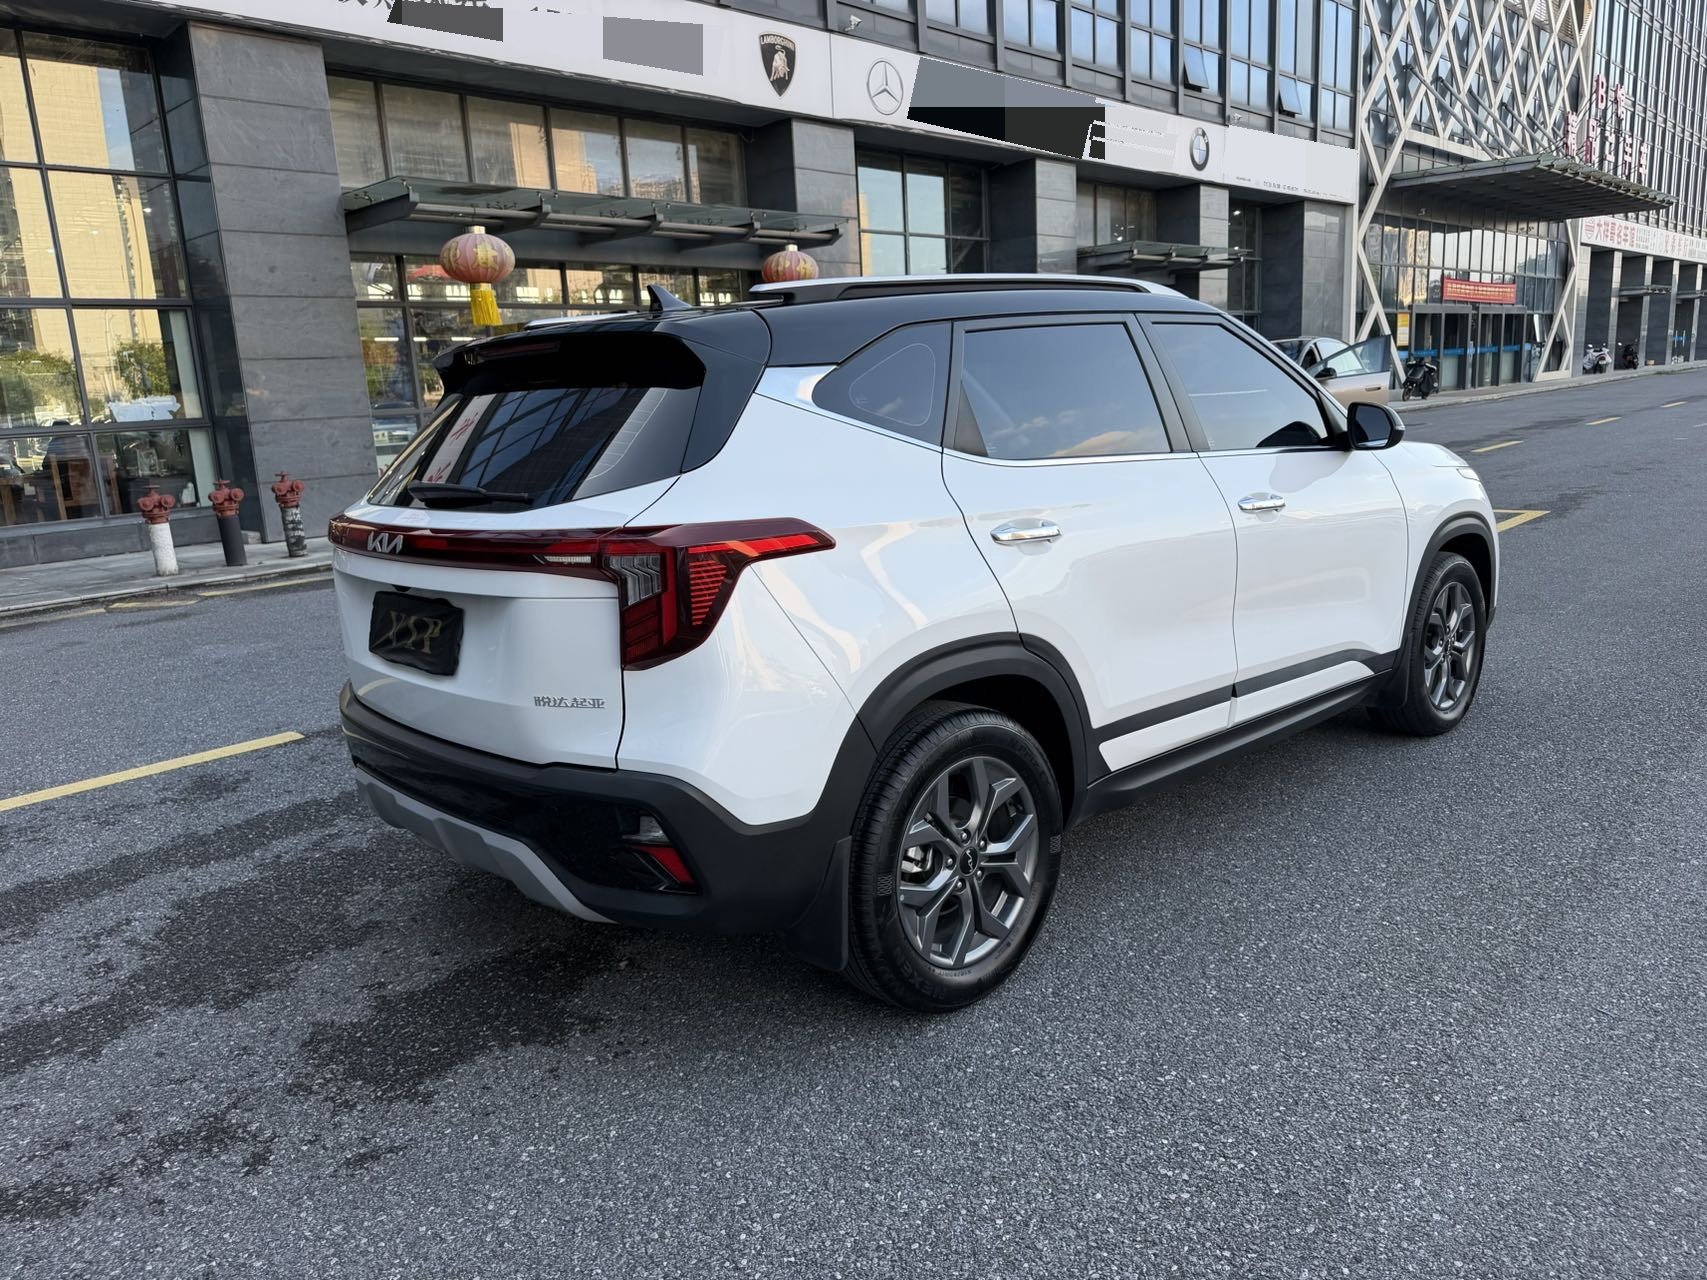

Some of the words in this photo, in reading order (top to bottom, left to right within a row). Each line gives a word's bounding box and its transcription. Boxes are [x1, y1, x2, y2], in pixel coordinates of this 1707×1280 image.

[367, 530, 404, 555] KIA
[533, 695, 606, 709] 悦达起亚
